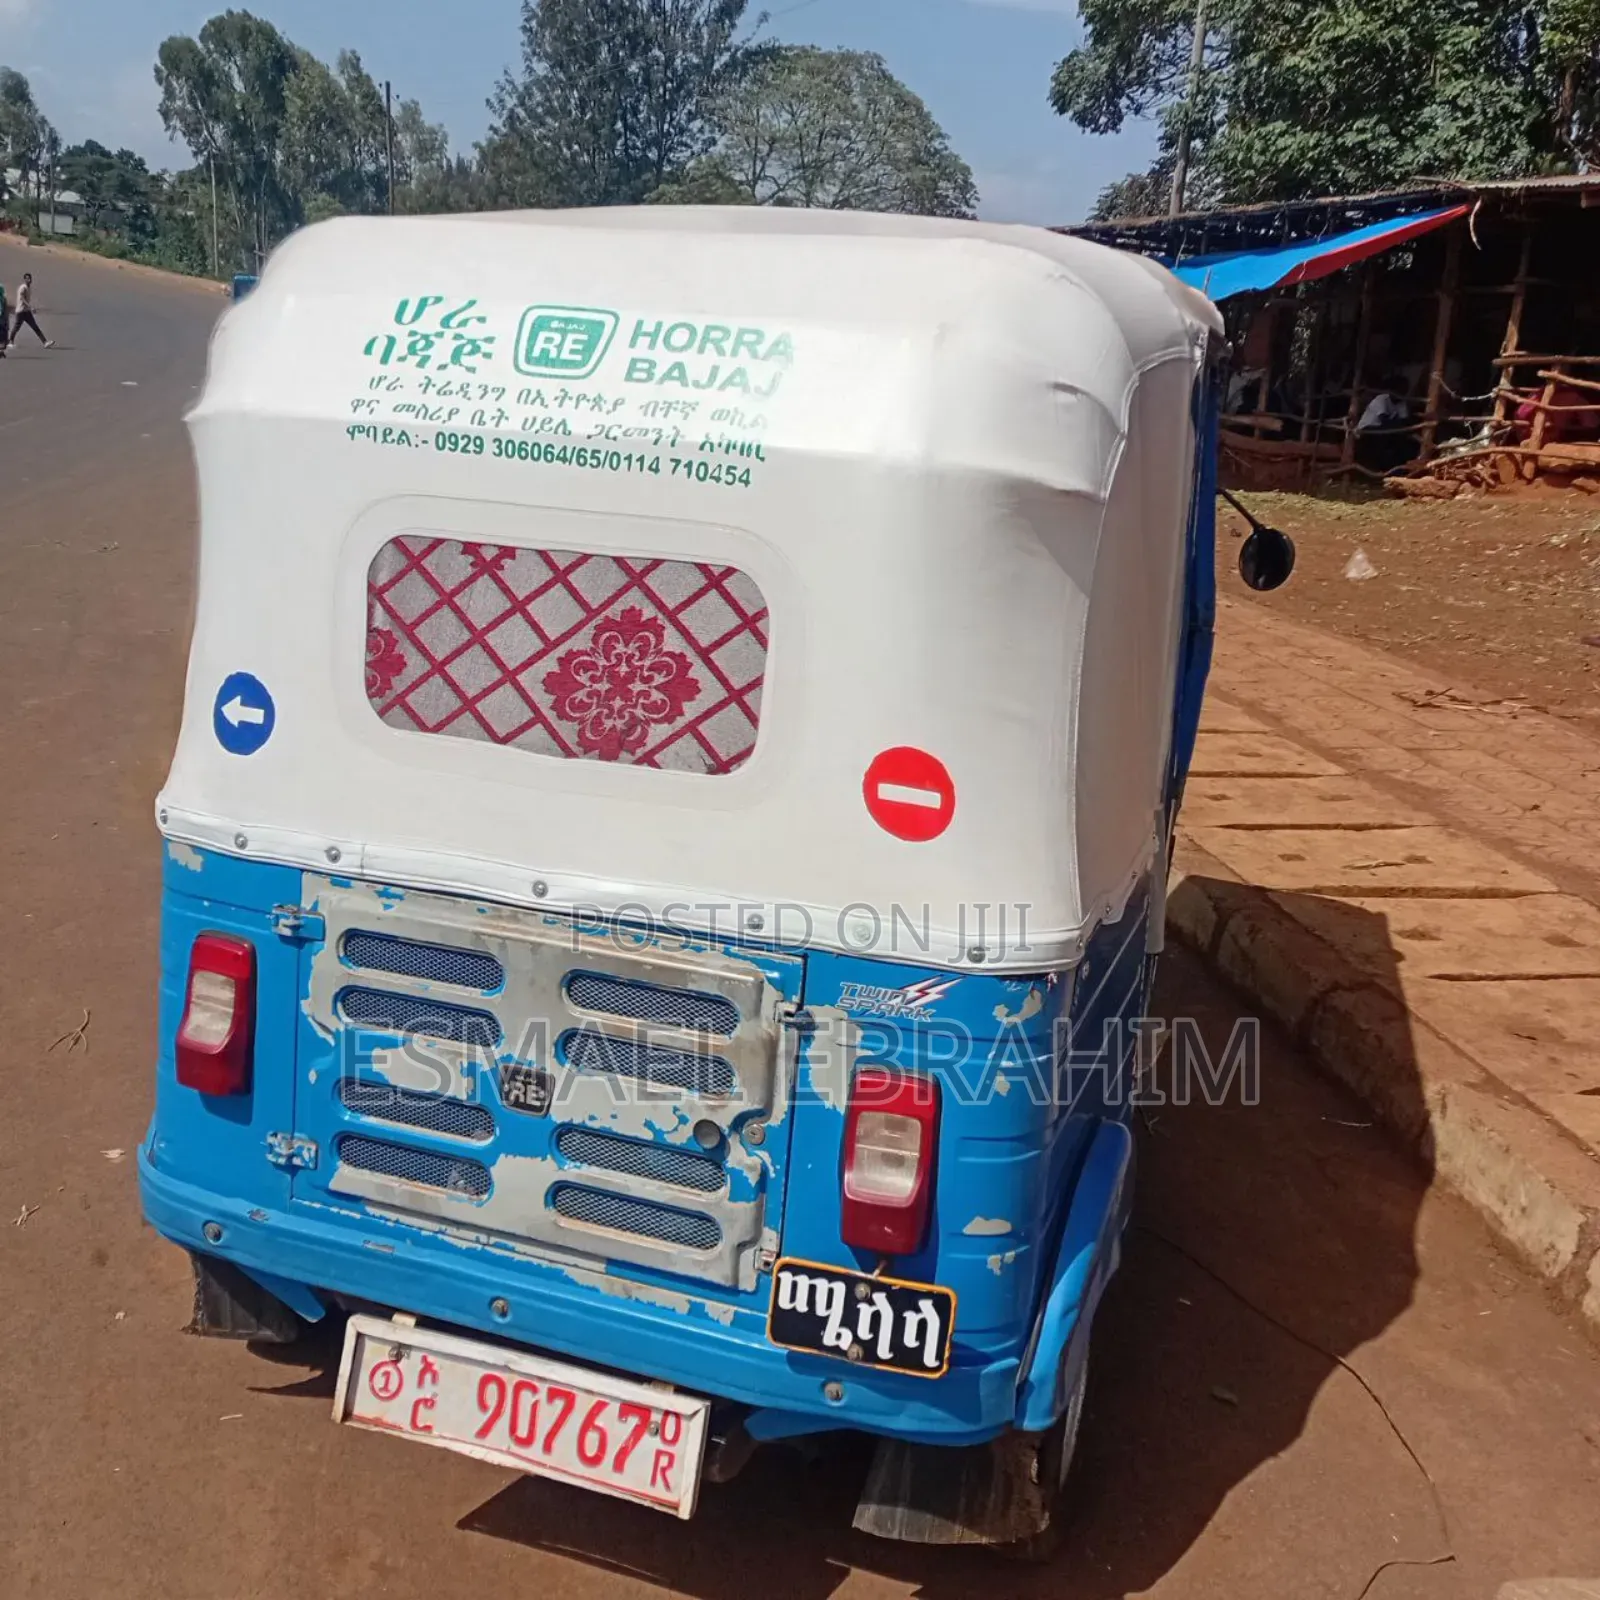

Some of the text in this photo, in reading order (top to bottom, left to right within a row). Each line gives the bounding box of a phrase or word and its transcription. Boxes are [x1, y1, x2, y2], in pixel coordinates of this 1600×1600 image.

[394, 296, 487, 330] ሆራ
[363, 330, 496, 374] ባጃጅ
[532, 331, 589, 361] RE
[628, 319, 794, 370] HORRA
[369, 375, 405, 393] ሆራ
[624, 357, 783, 399] BAJAJ
[470, 407, 510, 429] ቤት
[434, 431, 486, 456] 0929
[492, 437, 661, 476] 306064/65/0114
[669, 458, 752, 488] 710454
[836, 996, 936, 1022] SPARK
[840, 982, 909, 1004] TWIN
[509, 1081, 542, 1107] RE
[474, 1372, 653, 1475] 90767
